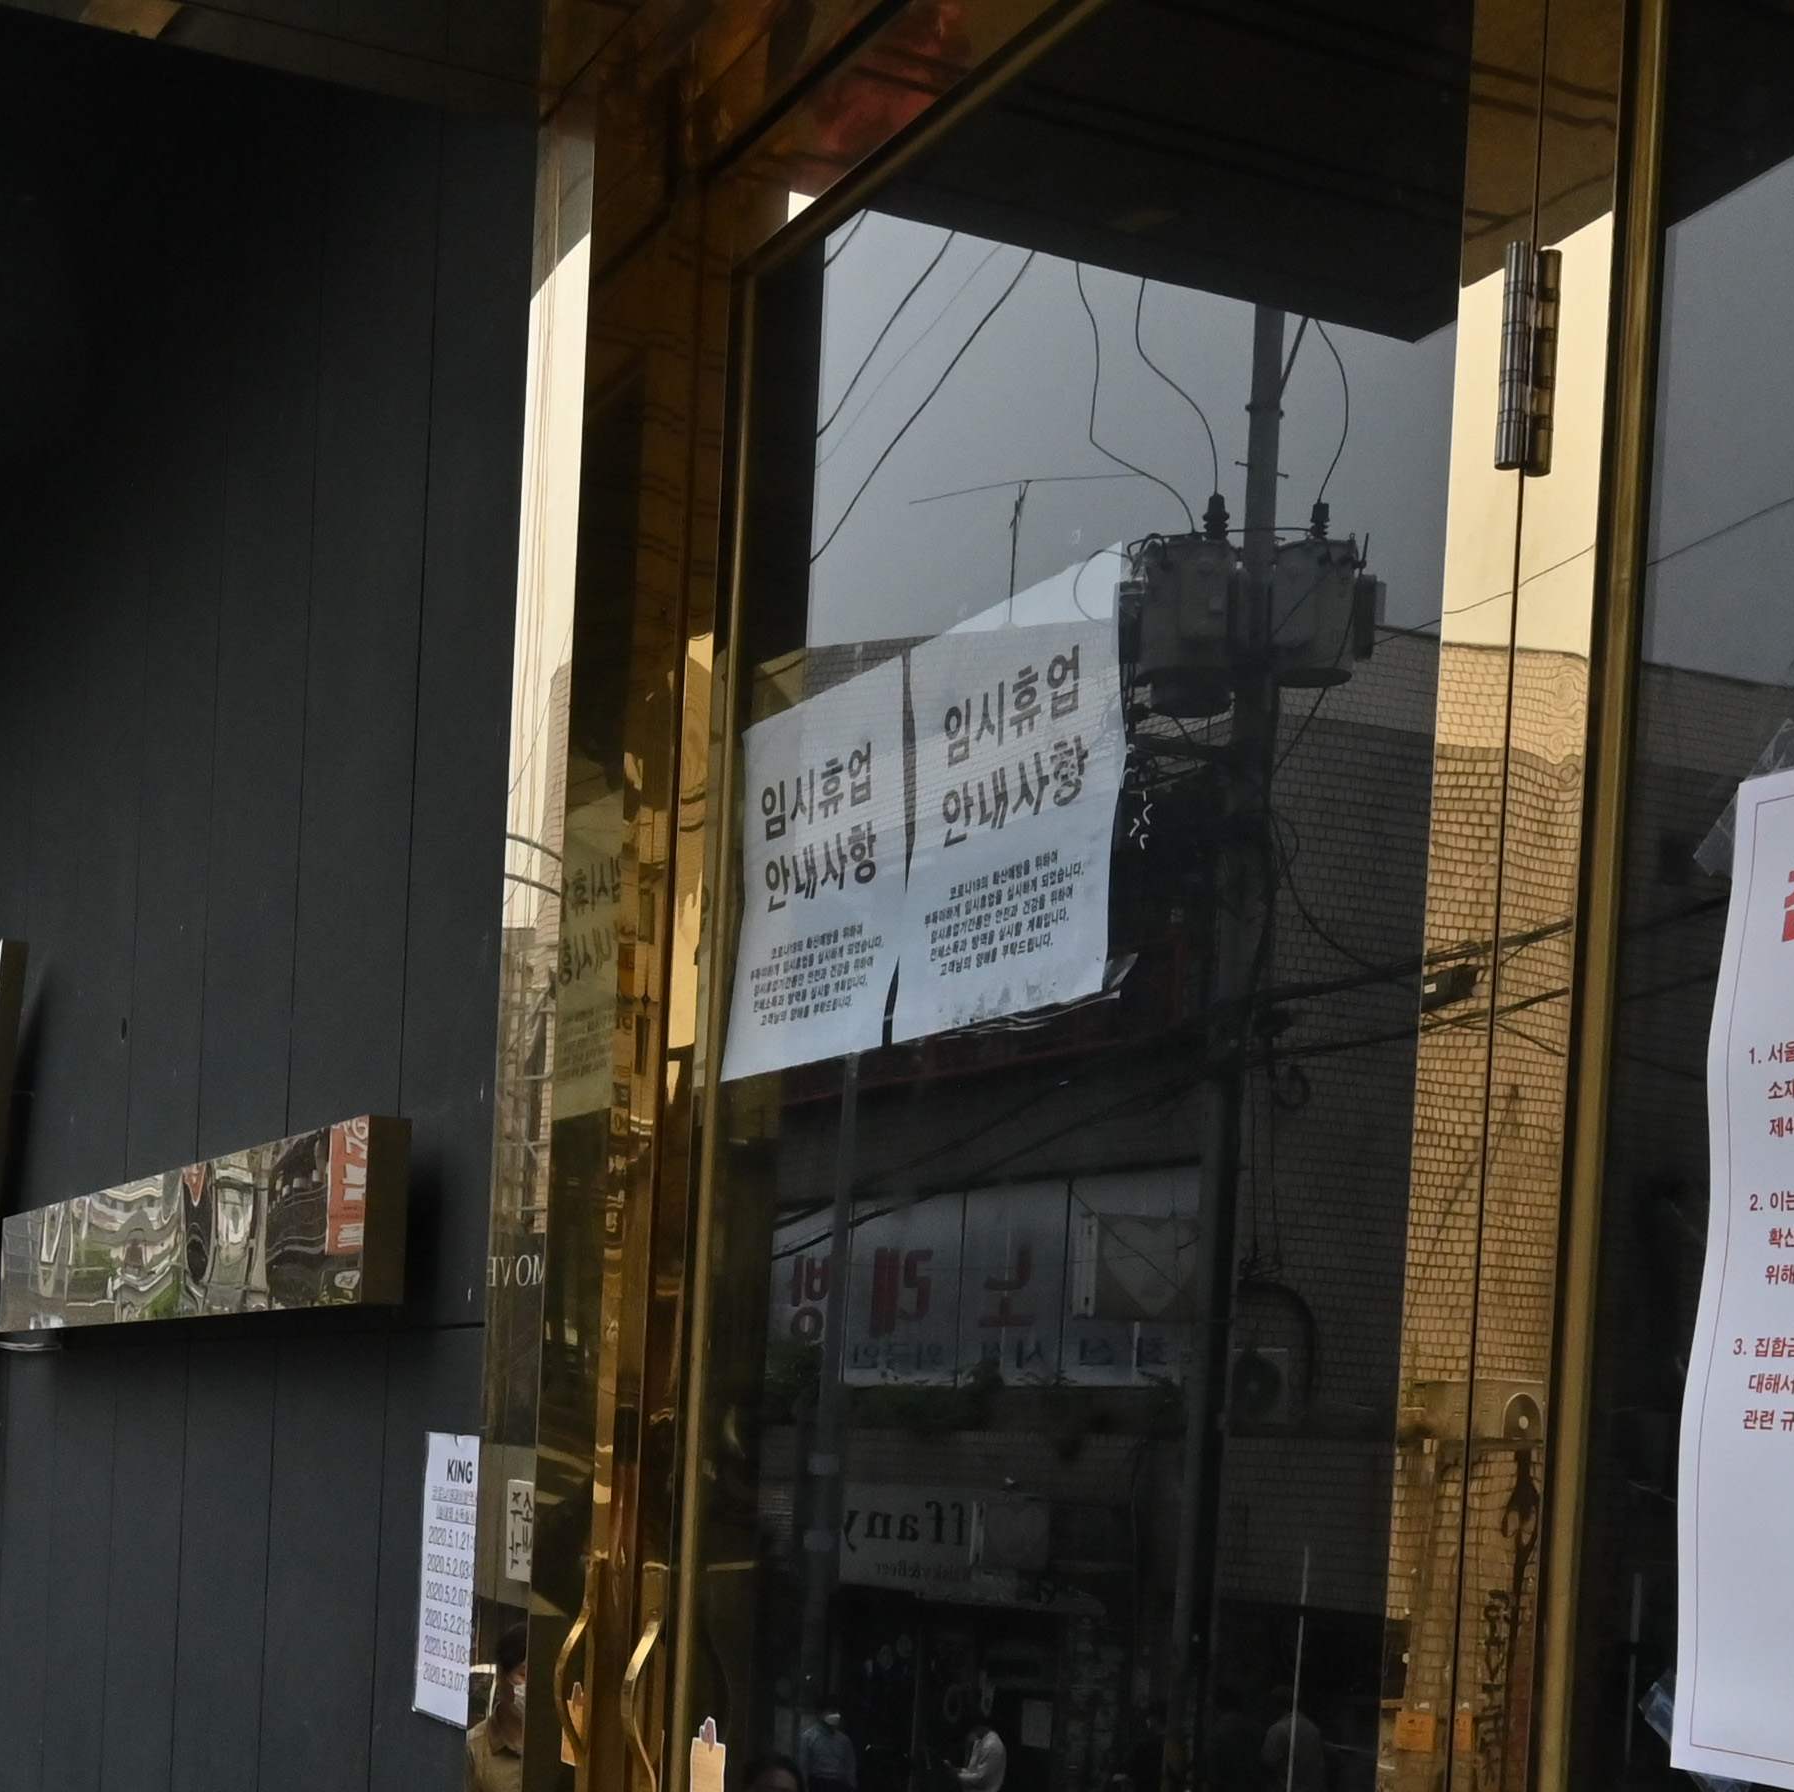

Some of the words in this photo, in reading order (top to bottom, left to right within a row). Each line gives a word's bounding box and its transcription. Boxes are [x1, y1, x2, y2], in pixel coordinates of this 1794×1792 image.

[944, 644, 1082, 768] 임시휴업
[761, 741, 872, 843] 임시휴업
[942, 734, 1089, 848] 안내사항
[764, 820, 877, 913] 안내사항
[1749, 1048, 1761, 1064] 1.
[1750, 1193, 1763, 1212] 2.
[1733, 1338, 1747, 1355] 3.
[1742, 1409, 1775, 1431] 관련
[447, 1459, 473, 1483] KING
